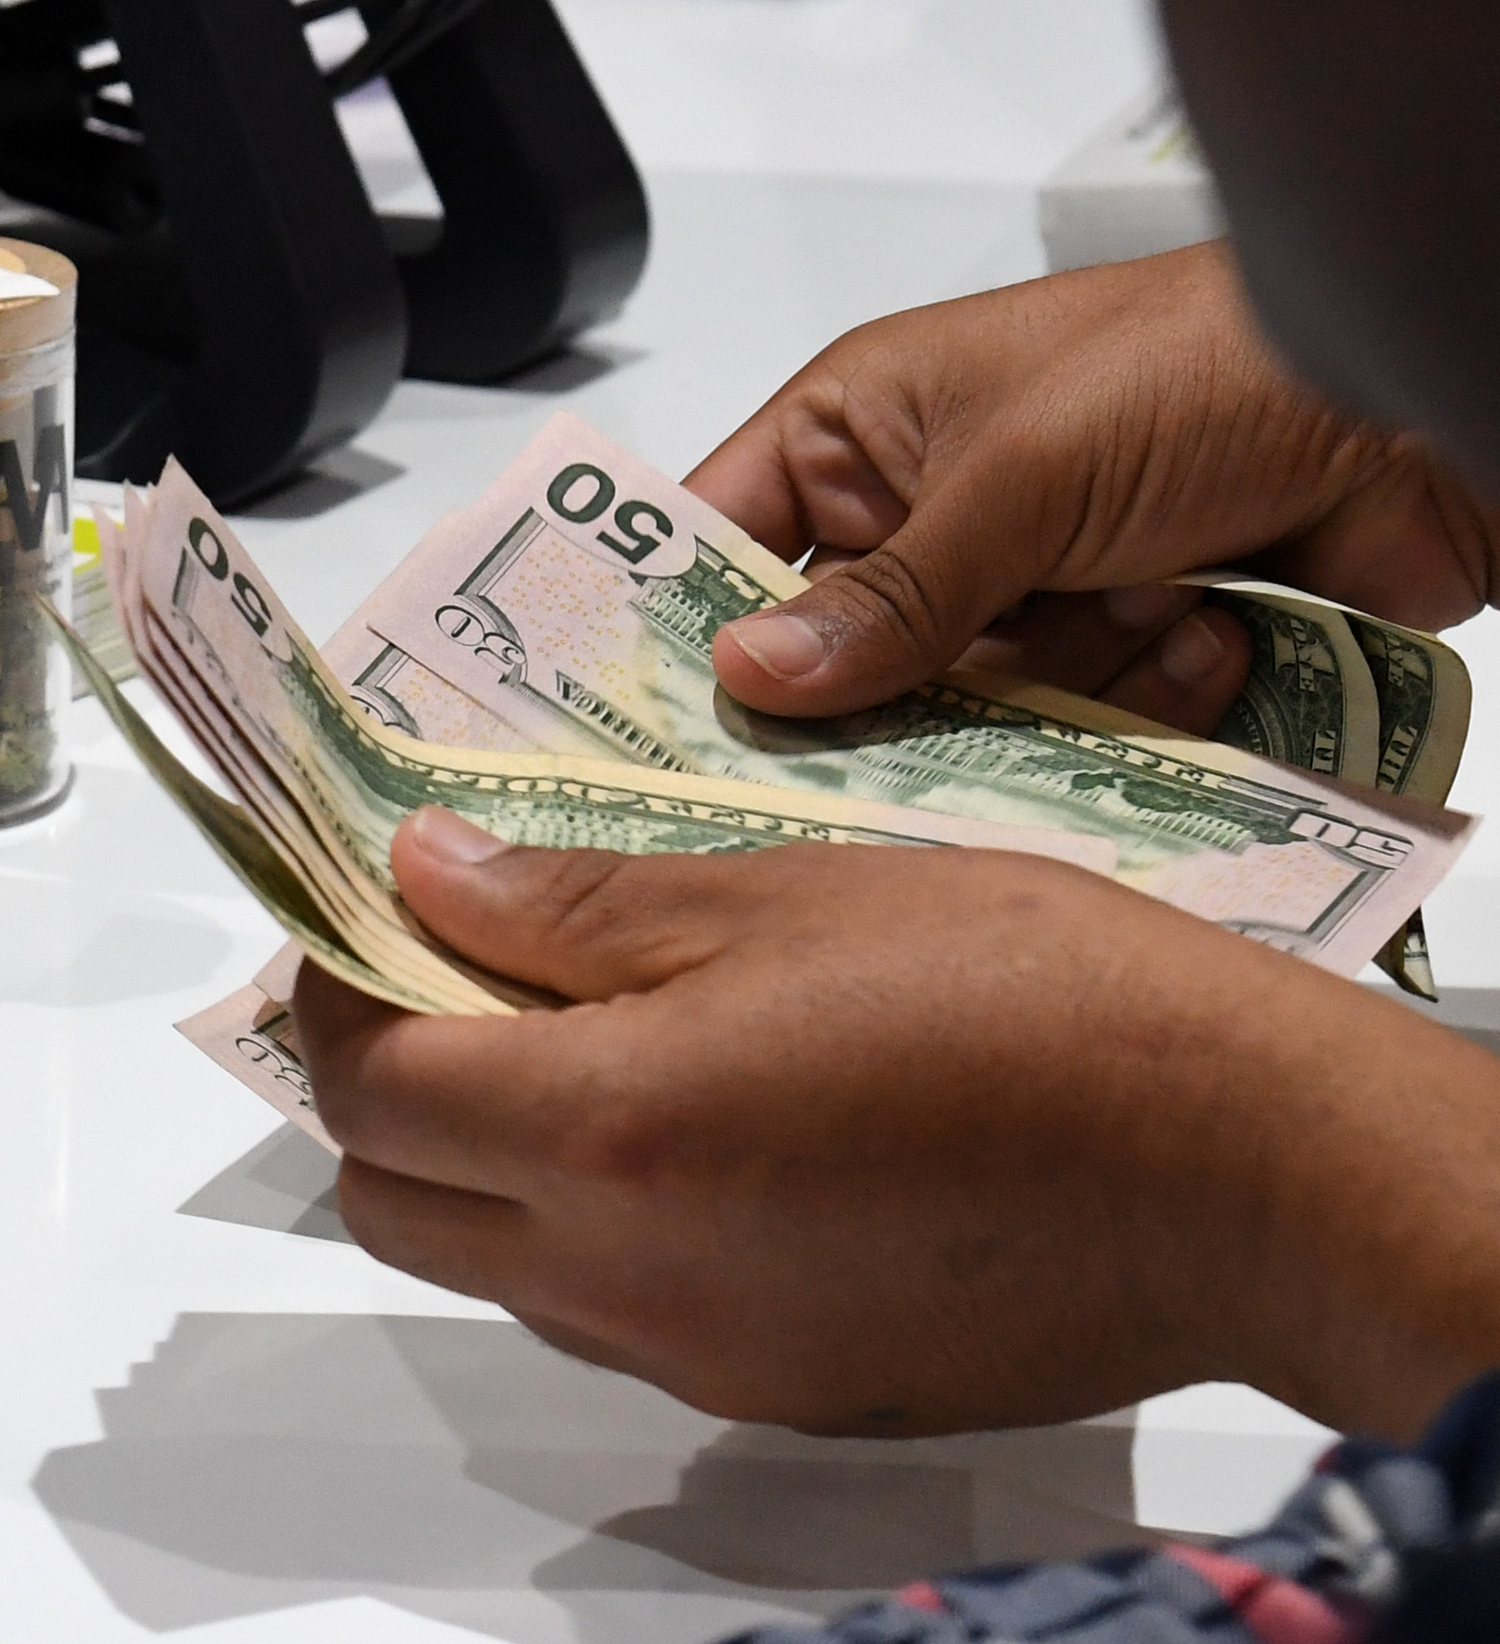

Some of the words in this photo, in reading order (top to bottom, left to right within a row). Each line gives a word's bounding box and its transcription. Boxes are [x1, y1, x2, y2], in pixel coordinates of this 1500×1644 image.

[546, 462, 674, 565] 50
[187, 516, 270, 636] 50
[434, 604, 527, 682] 50
[1285, 808, 1415, 868] 50
